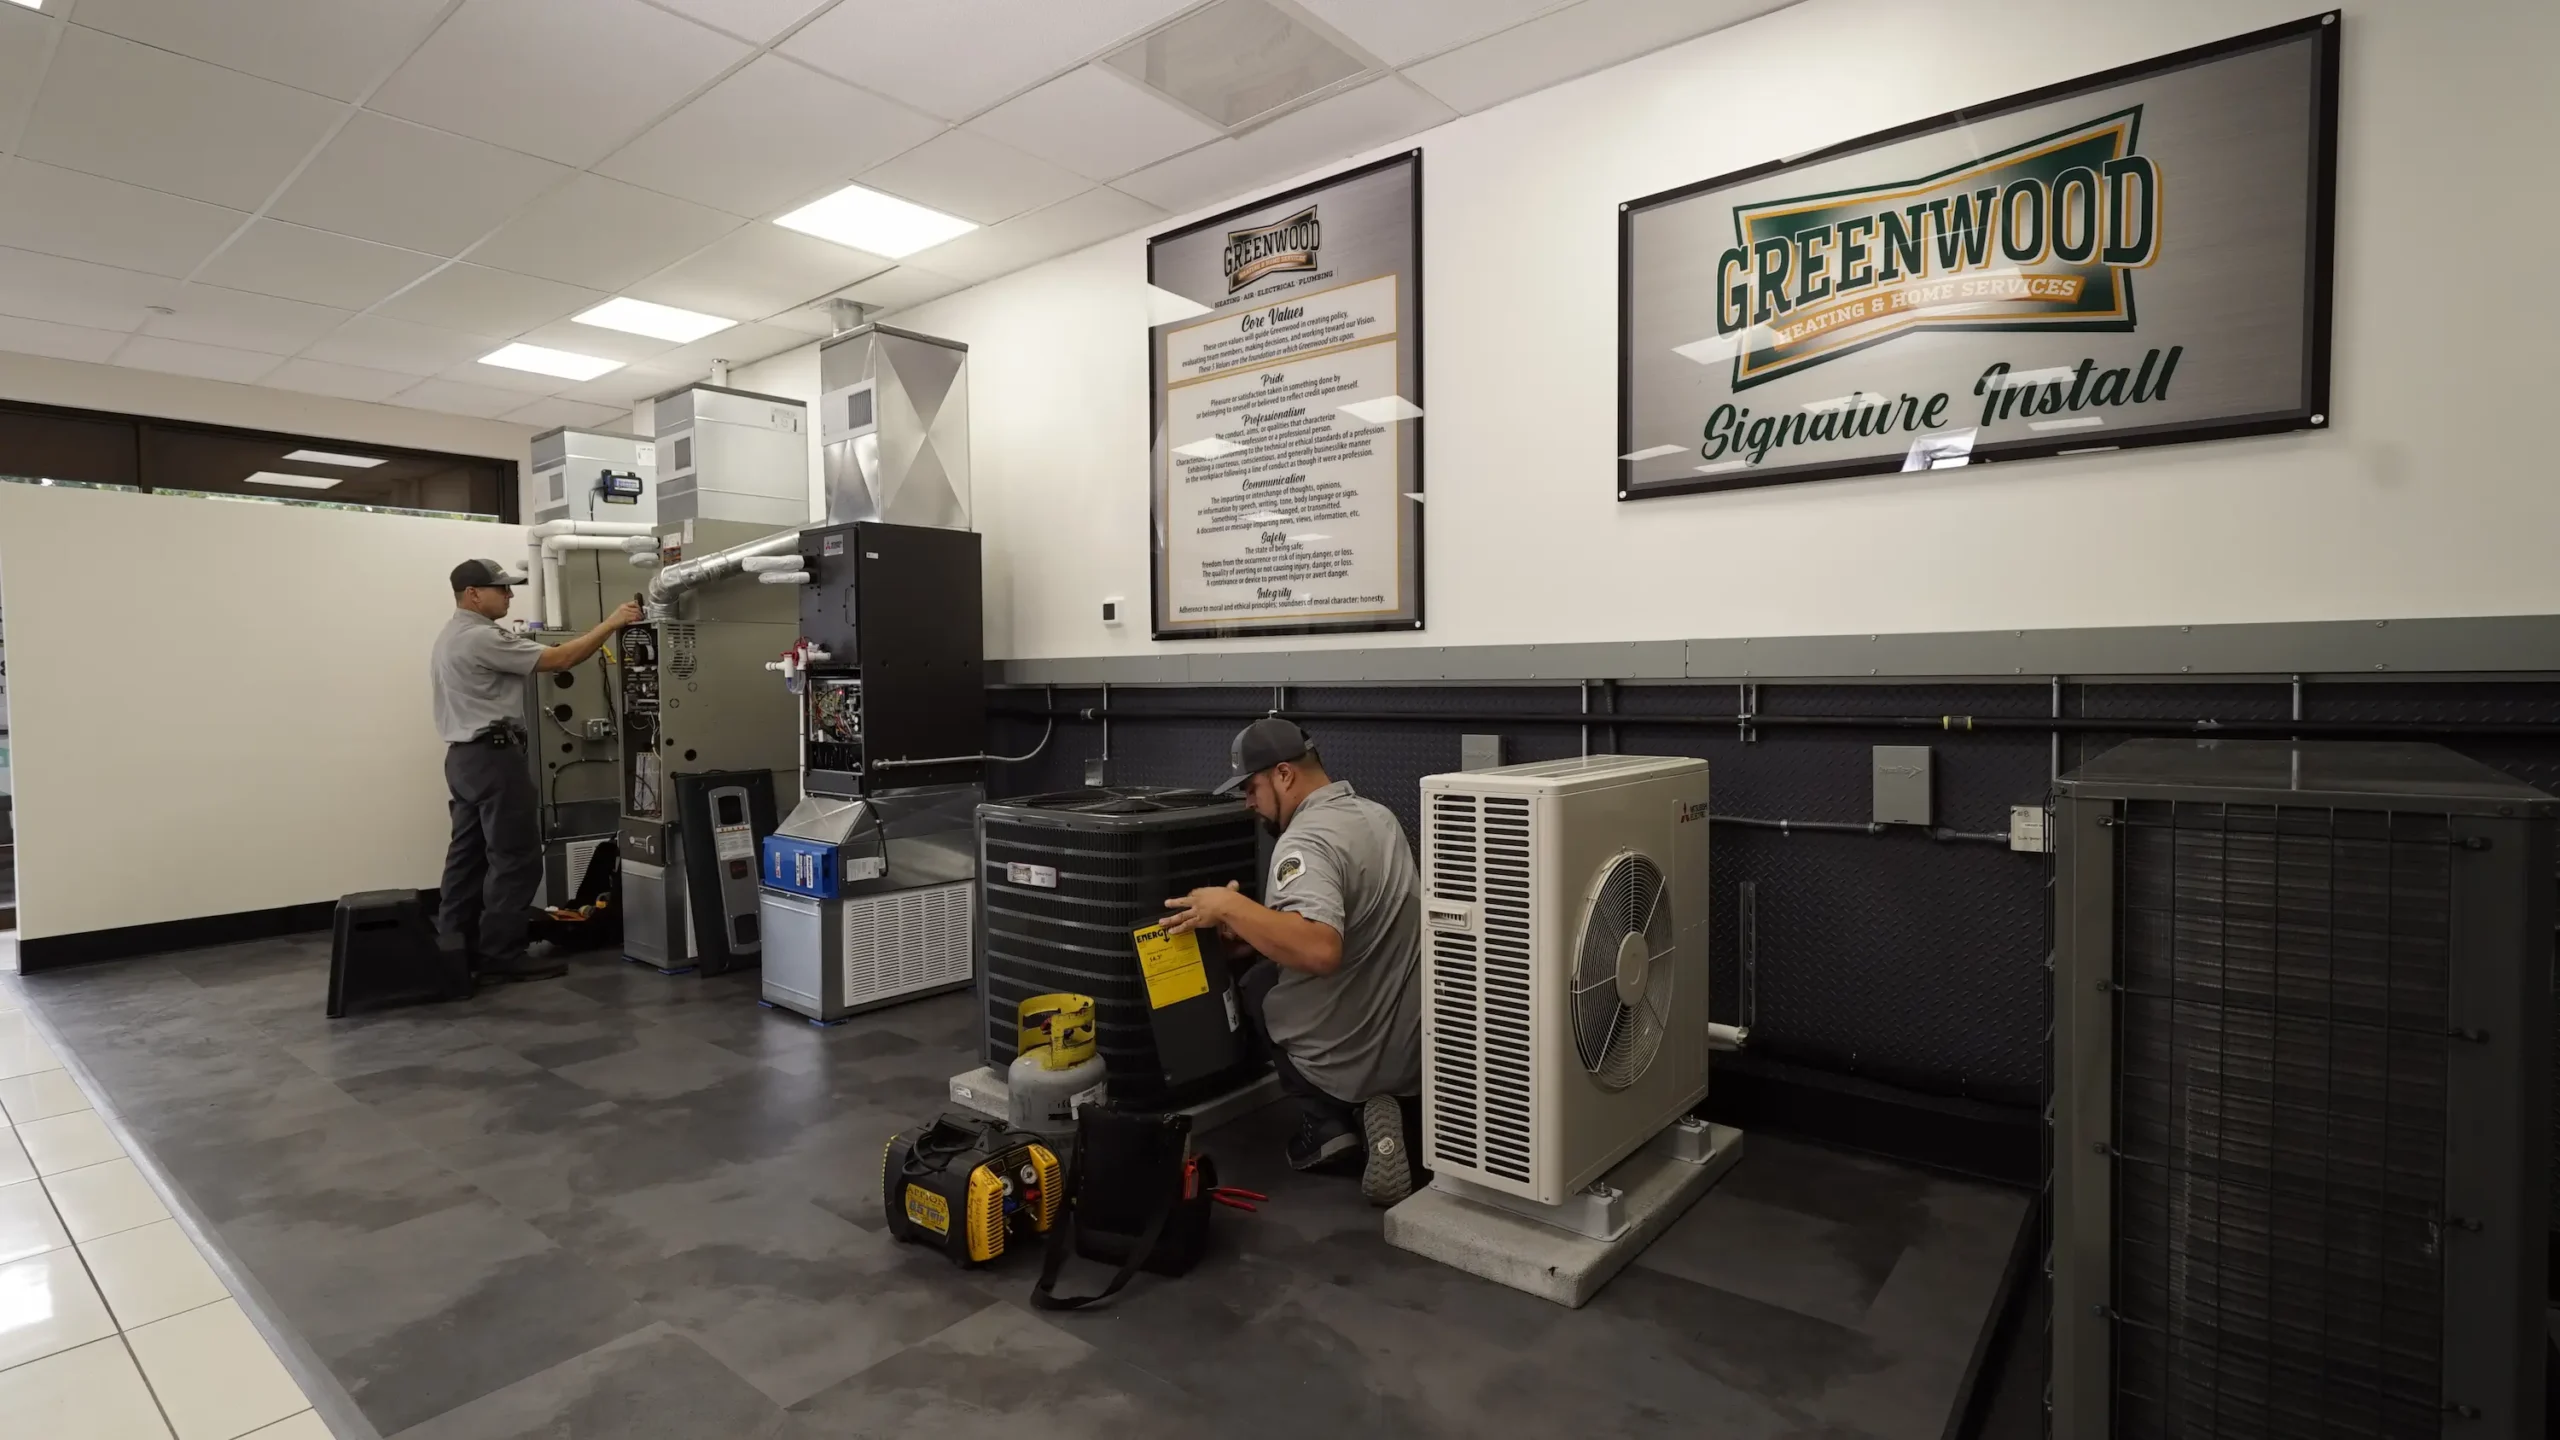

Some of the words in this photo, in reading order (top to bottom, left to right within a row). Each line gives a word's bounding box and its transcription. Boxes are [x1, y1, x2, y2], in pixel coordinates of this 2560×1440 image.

[1224, 219, 1320, 277] GREENWOOD
[1716, 154, 2160, 341] GREENWOOD
[1214, 295, 1241, 308] HEATING
[1243, 291, 1254, 300] AIR
[1257, 281, 1296, 297] ELECTRICAL
[1298, 270, 1333, 286] PLUMBING
[1241, 314, 1265, 332] Core
[1268, 307, 1304, 325] Values
[1776, 305, 1864, 346] HEATING
[1871, 297, 1884, 313] &
[1891, 281, 1954, 310] HOME
[1960, 277, 2078, 300] SERVICES
[1203, 343, 1217, 351] These
[1228, 337, 1244, 345] values
[1244, 332, 1255, 341] will
[1254, 329, 1270, 340] guide
[1269, 321, 1300, 335] Greenwood
[1306, 316, 1330, 326] creating
[1181, 356, 1207, 367] evaluating
[1206, 353, 1220, 361] team
[1244, 342, 1264, 352] making
[1290, 332, 1301, 342] and
[1301, 328, 1325, 338] working
[1324, 321, 1346, 333] toward
[1198, 365, 1211, 373] These
[1239, 356, 1248, 364] the
[1248, 350, 1276, 362] foundation
[1282, 344, 1298, 354] which
[1298, 337, 1329, 350] Greenwood
[1260, 373, 1284, 387] Pride
[1210, 397, 1231, 406] Pleasure
[1237, 390, 1267, 401] satisfaction
[1267, 387, 1282, 395] taken
[1289, 380, 1318, 391] something
[1318, 377, 1333, 385] done
[1201, 408, 1226, 418] belonging
[1232, 401, 1251, 412] oneself
[1257, 396, 1280, 407] believed
[1286, 392, 1304, 401] reflect
[1304, 387, 1321, 397] credit
[1321, 386, 1336, 395] upon
[1701, 392, 1949, 467] Signature
[1973, 346, 2184, 428] Install
[1241, 407, 1306, 426] Professionalism
[1266, 422, 1290, 432] qualities
[1290, 419, 1302, 427] that
[1302, 414, 1336, 425] characterize
[1254, 445, 1264, 453] the
[1263, 440, 1288, 452] technical
[1294, 436, 1314, 446] ethical
[1314, 432, 1342, 443] standards
[1278, 426, 1311, 441] professional
[1187, 465, 1211, 474] Exhibiting
[1276, 451, 1288, 459] and
[1287, 447, 1313, 459] generally
[1313, 442, 1348, 454] businesslike
[1348, 439, 1371, 448] manner
[1199, 472, 1224, 481] workplace
[1223, 468, 1247, 477] following
[1268, 461, 1290, 470] conduct
[1296, 456, 1317, 466] though
[1242, 473, 1306, 491] Communication
[1203, 506, 1232, 515] information
[1293, 494, 1308, 504] body
[1308, 493, 1334, 502] language
[1220, 494, 1245, 504] imparting
[1251, 489, 1282, 499] interchange
[1200, 526, 1225, 534] document
[1230, 523, 1253, 531] message
[1252, 520, 1279, 529] imparting
[1211, 514, 1238, 523] Something
[1254, 546, 1268, 554] state
[1274, 543, 1291, 552] being
[1261, 531, 1287, 546] Safety
[1278, 553, 1288, 561] risk
[1202, 570, 1212, 578] The
[1211, 569, 1229, 578] quality
[1235, 567, 1257, 575] averting
[1272, 564, 1294, 572] causing
[1244, 576, 1261, 584] device
[1267, 574, 1288, 583] prevent
[1288, 573, 1305, 582] injury
[1312, 571, 1327, 579] avert
[1257, 587, 1292, 601] Integrity
[1209, 604, 1224, 612] moral
[1223, 603, 1234, 611] and
[1233, 602, 1251, 610] ethical
[1313, 597, 1330, 605] moral
